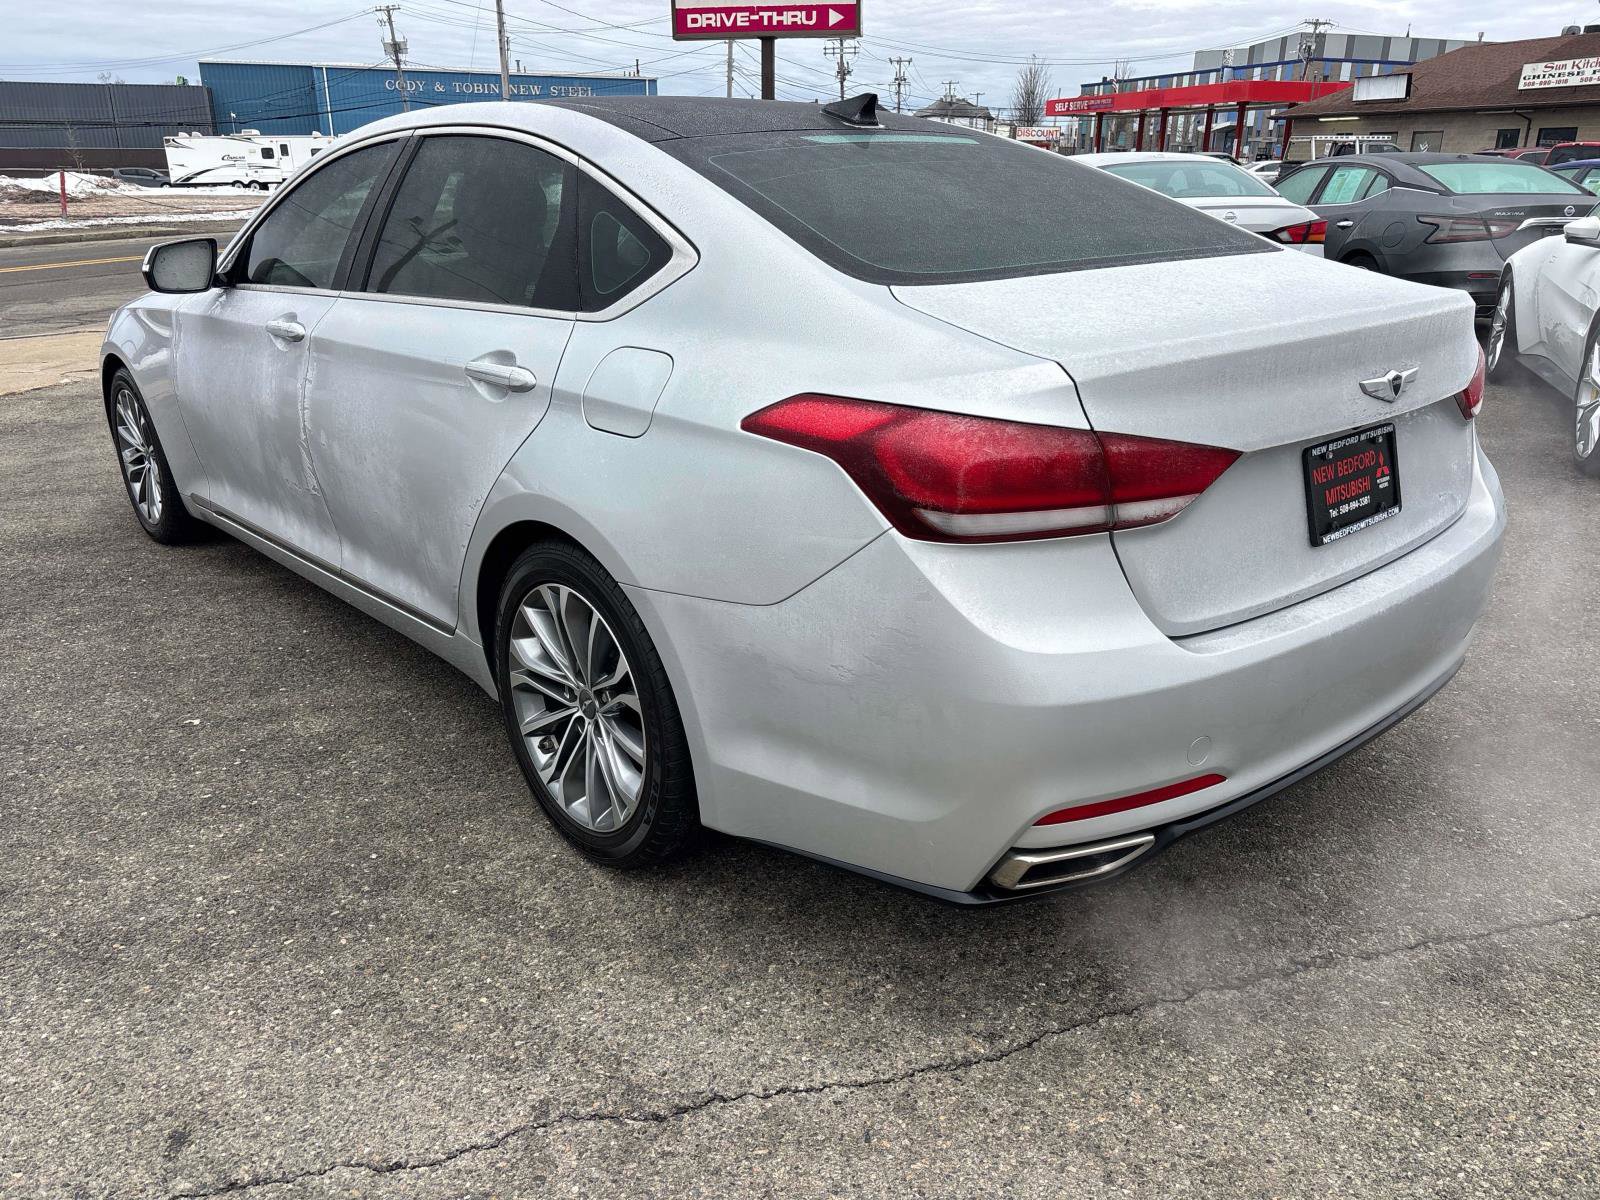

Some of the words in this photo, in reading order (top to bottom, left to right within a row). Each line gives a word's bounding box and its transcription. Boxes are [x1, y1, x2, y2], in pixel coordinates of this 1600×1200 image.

[687, 10, 817, 28] DRIVE-THRU
[1543, 63, 1567, 72] Sun
[385, 80, 425, 92] CODY
[434, 81, 446, 92] &
[453, 82, 500, 94] TOBIN
[508, 84, 542, 96] NEW
[550, 86, 596, 97] STEEL
[1055, 102, 1069, 112] SELF
[1069, 100, 1088, 111] SERVE
[1017, 129, 1059, 138] DISCOUNT
[1312, 445, 1327, 456] NEW
[1328, 436, 1359, 451] BEDFORD
[1360, 425, 1394, 442] MITSUBISHI
[1313, 464, 1335, 485] NEW
[1337, 450, 1376, 477] BEDFORD
[1325, 476, 1371, 506] MITSUBISHI
[1329, 508, 1339, 519] Tel:
